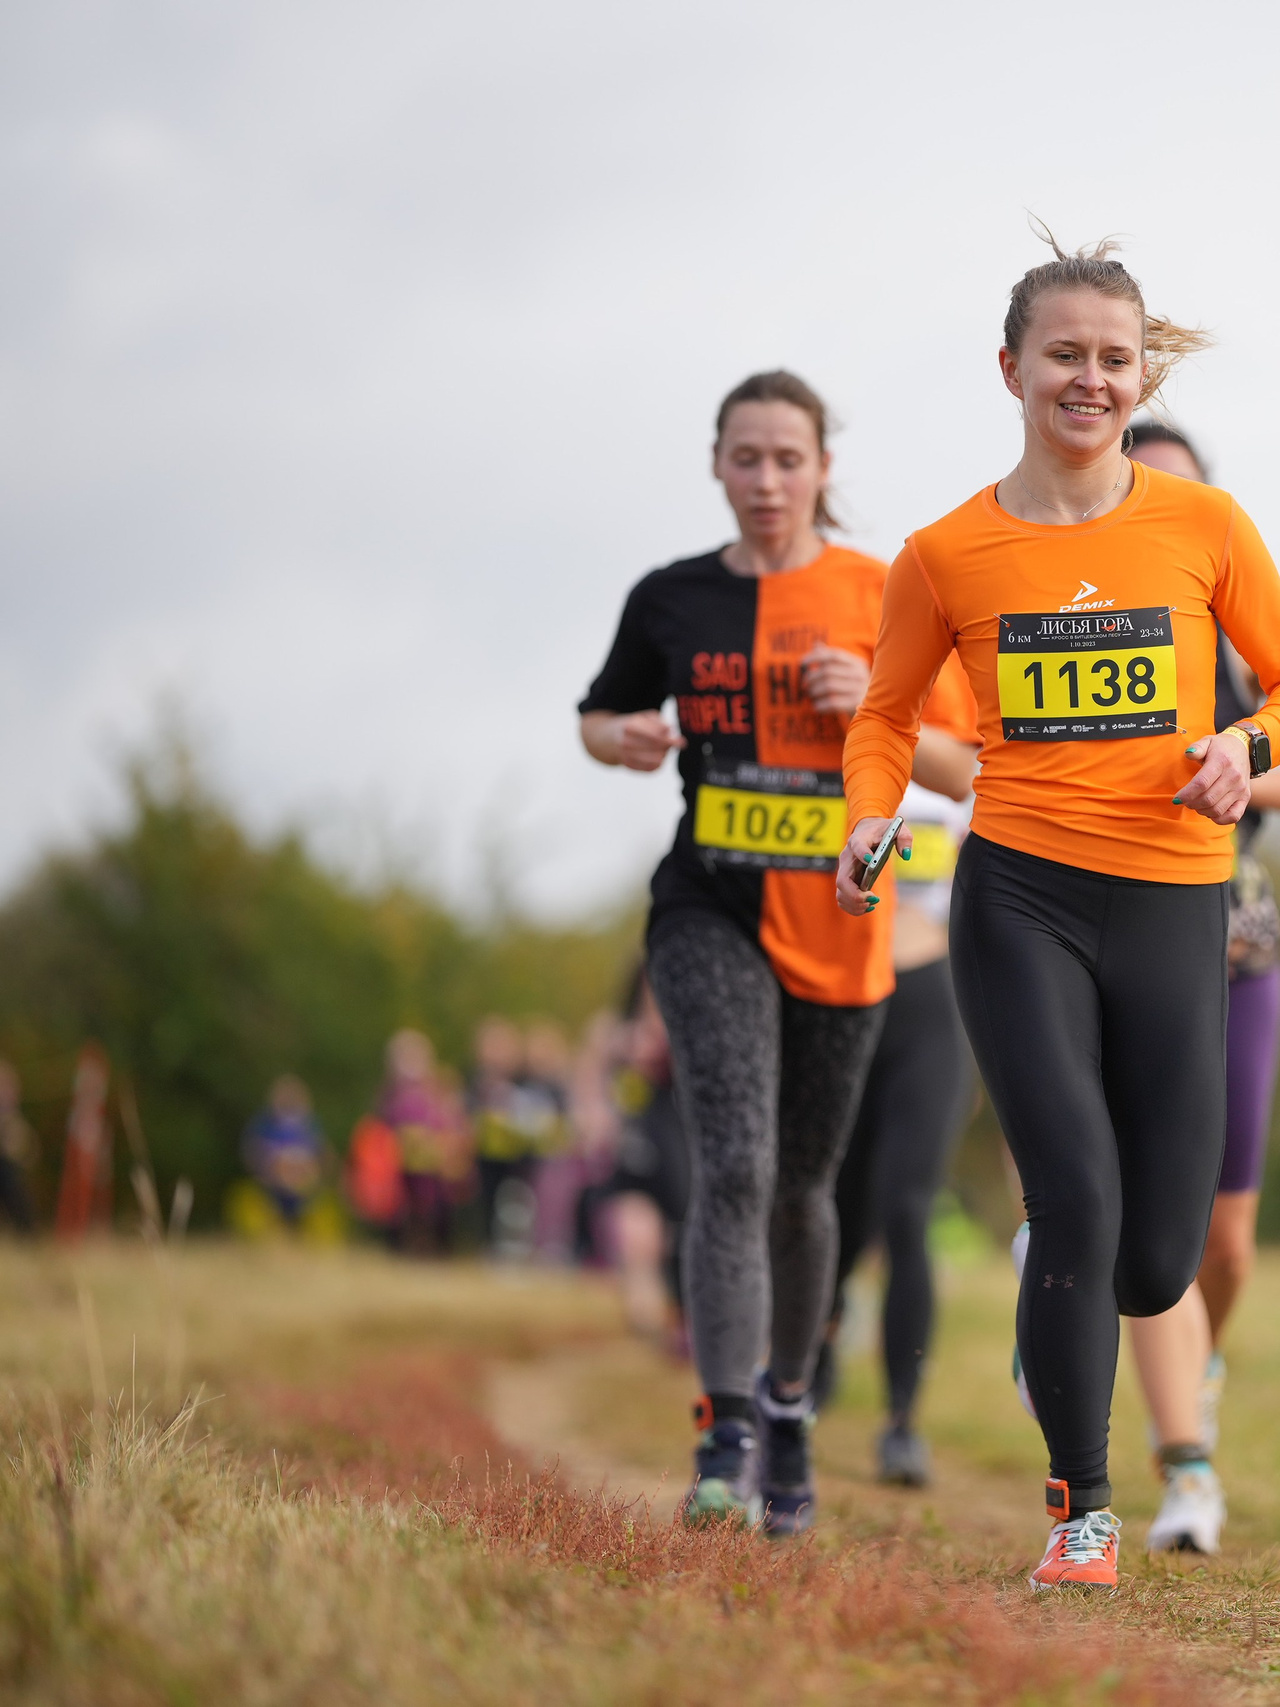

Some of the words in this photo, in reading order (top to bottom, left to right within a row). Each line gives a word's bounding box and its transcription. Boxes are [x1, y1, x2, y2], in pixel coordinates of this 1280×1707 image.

[1058, 599, 1116, 613] DEMIX
[1008, 631, 1015, 643] 6
[1036, 619, 1091, 635] ЛИСЬЯ
[1095, 616, 1135, 633] ГОРА
[691, 652, 748, 692] SAD
[1023, 656, 1157, 710] 1138
[720, 801, 828, 846] 1062
